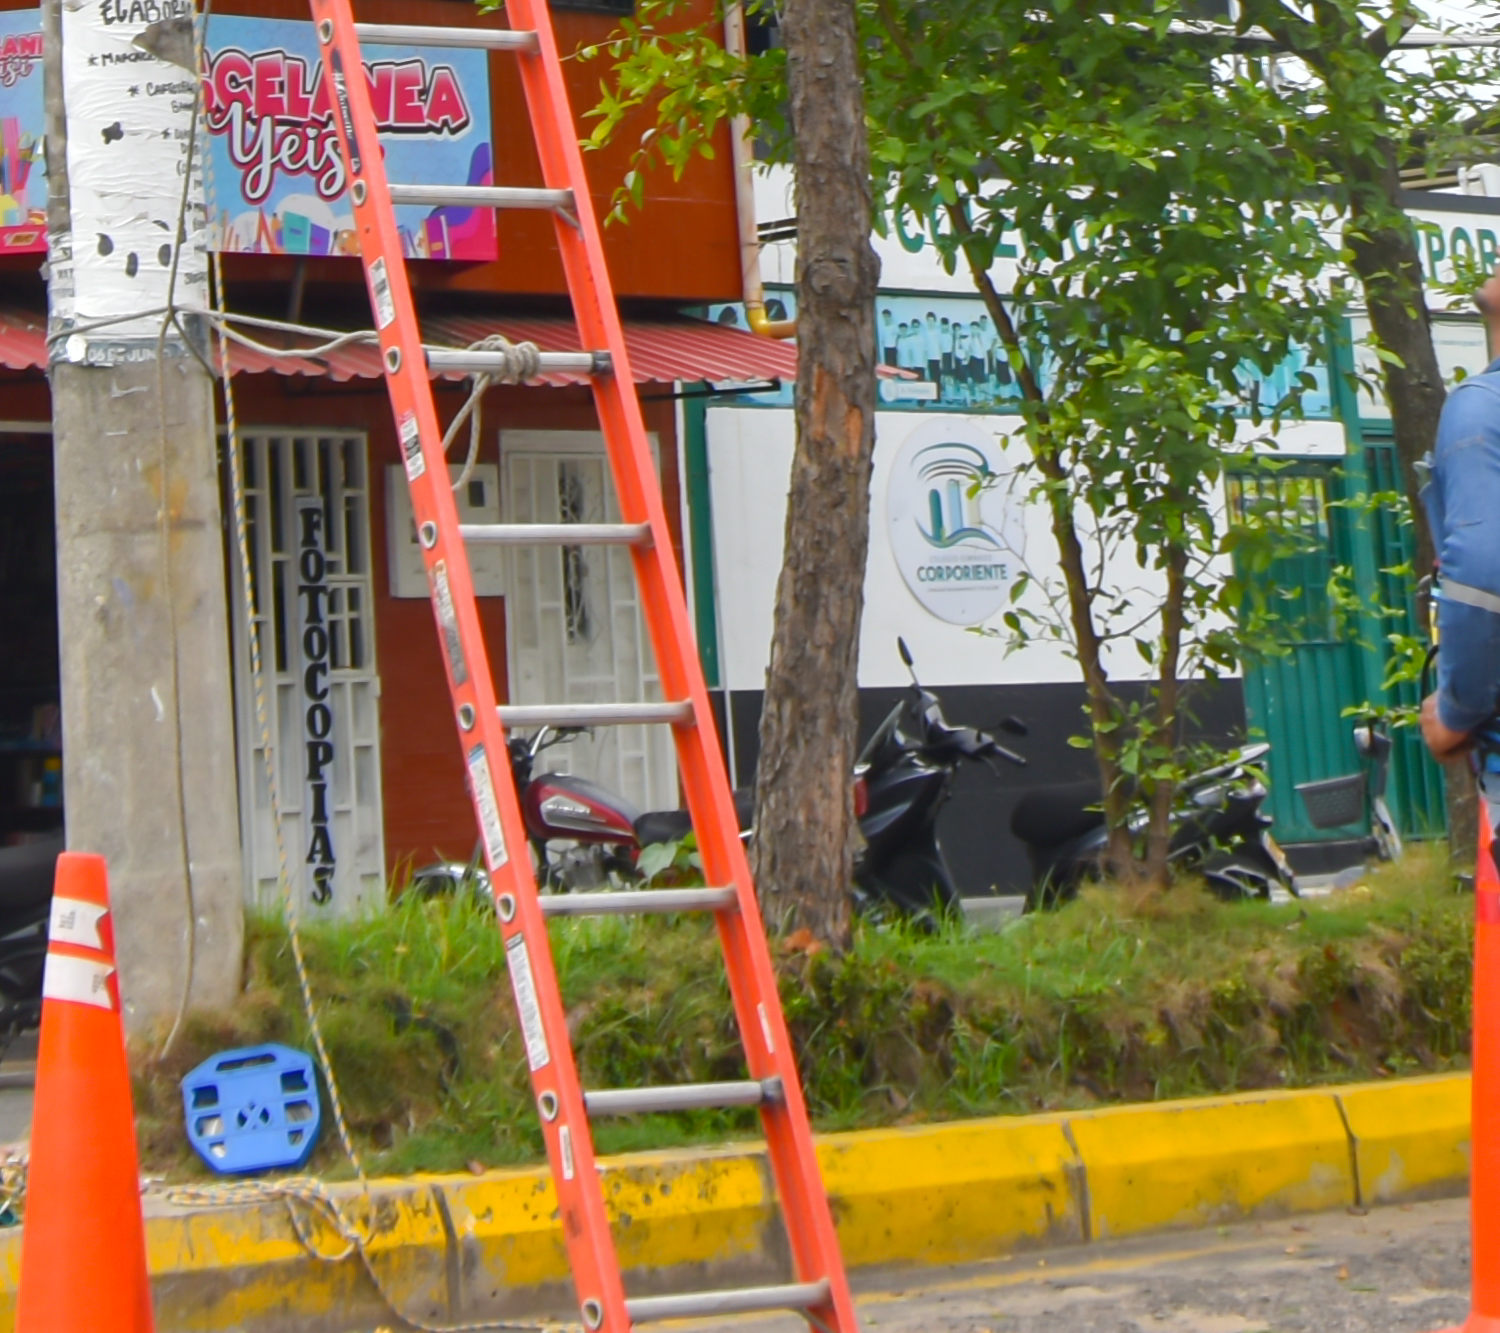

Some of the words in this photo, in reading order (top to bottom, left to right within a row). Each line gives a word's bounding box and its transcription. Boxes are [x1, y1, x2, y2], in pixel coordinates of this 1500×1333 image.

[206, 100, 352, 203] Yeis
[916, 563, 1008, 583] CORPORIENTE
[298, 507, 336, 908] FOTOCOPIAS
